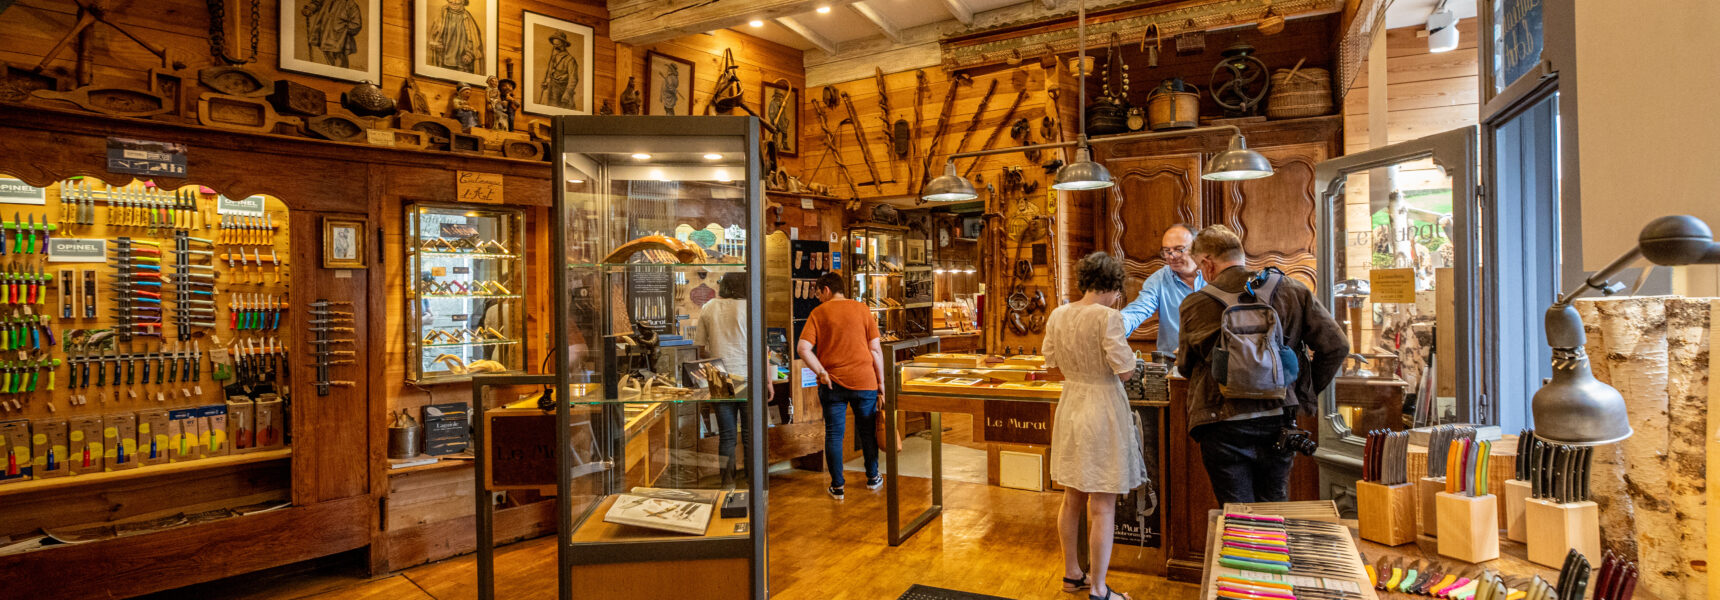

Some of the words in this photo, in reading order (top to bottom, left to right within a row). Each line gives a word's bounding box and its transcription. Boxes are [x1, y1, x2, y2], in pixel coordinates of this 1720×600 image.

[0, 184, 36, 192] PINEL
[56, 243, 99, 251] OPINEL
[987, 416, 1003, 427] Le
[1008, 418, 1047, 430] Murat
